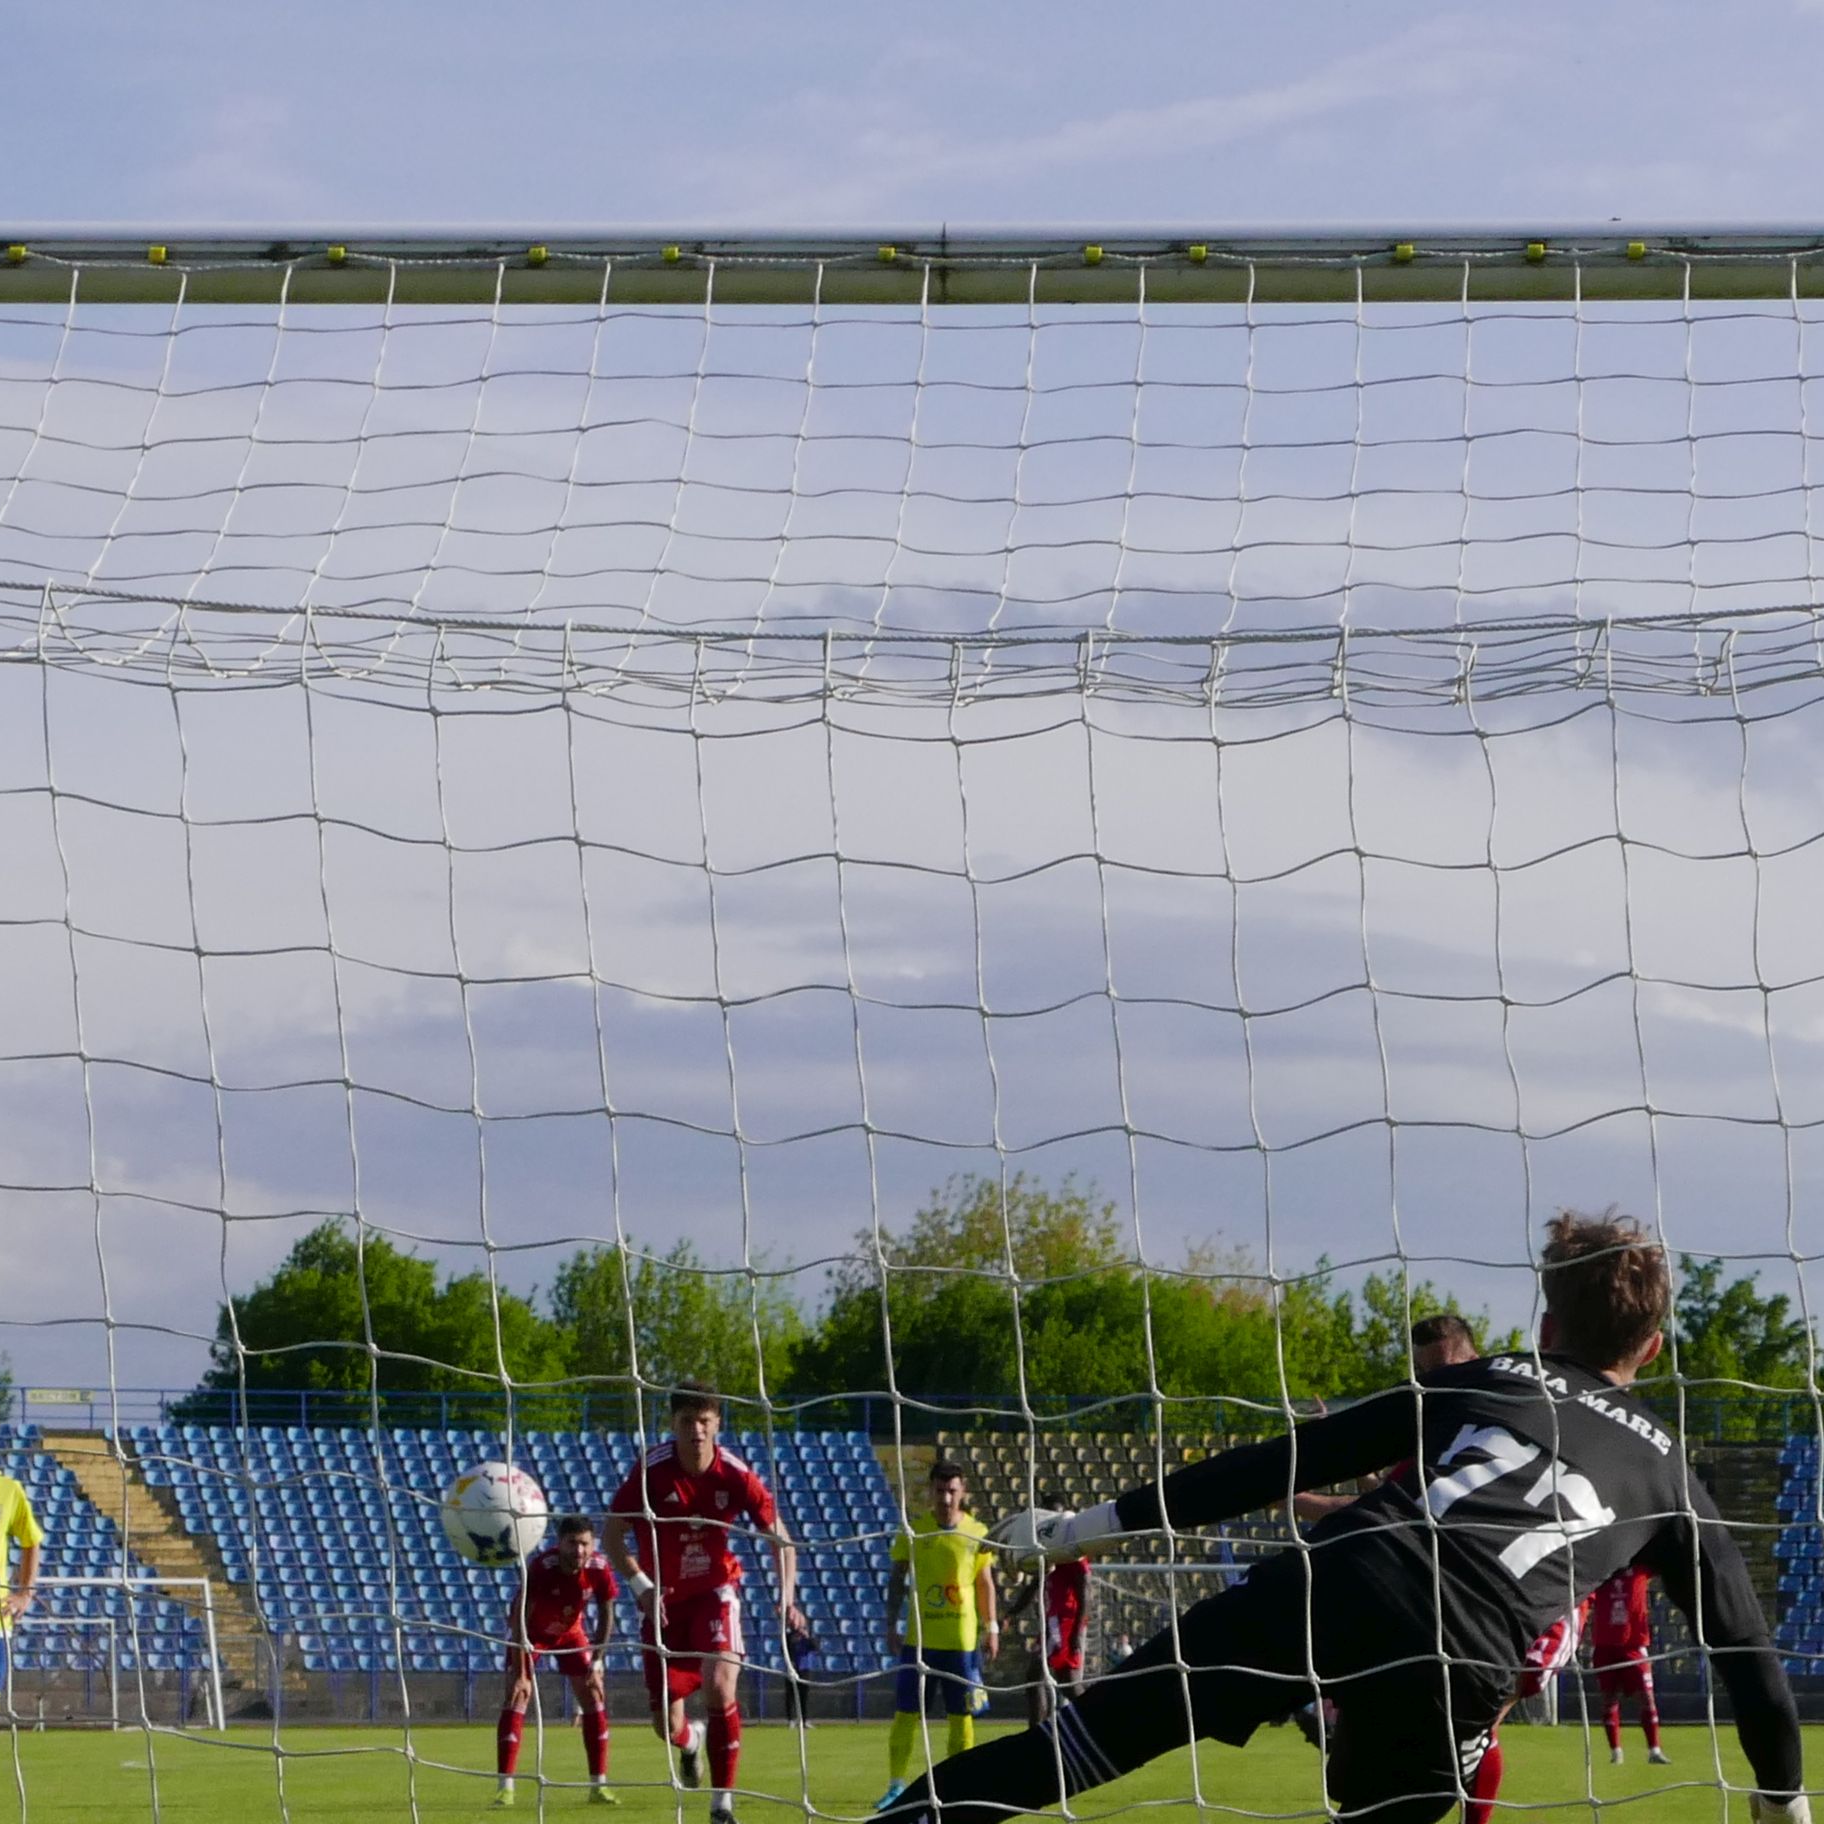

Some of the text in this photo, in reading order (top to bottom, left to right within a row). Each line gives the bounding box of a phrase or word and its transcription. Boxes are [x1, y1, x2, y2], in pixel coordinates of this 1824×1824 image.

[1488, 1356, 1673, 1457] BAIA MARE
[1414, 1422, 1617, 1580] 22
